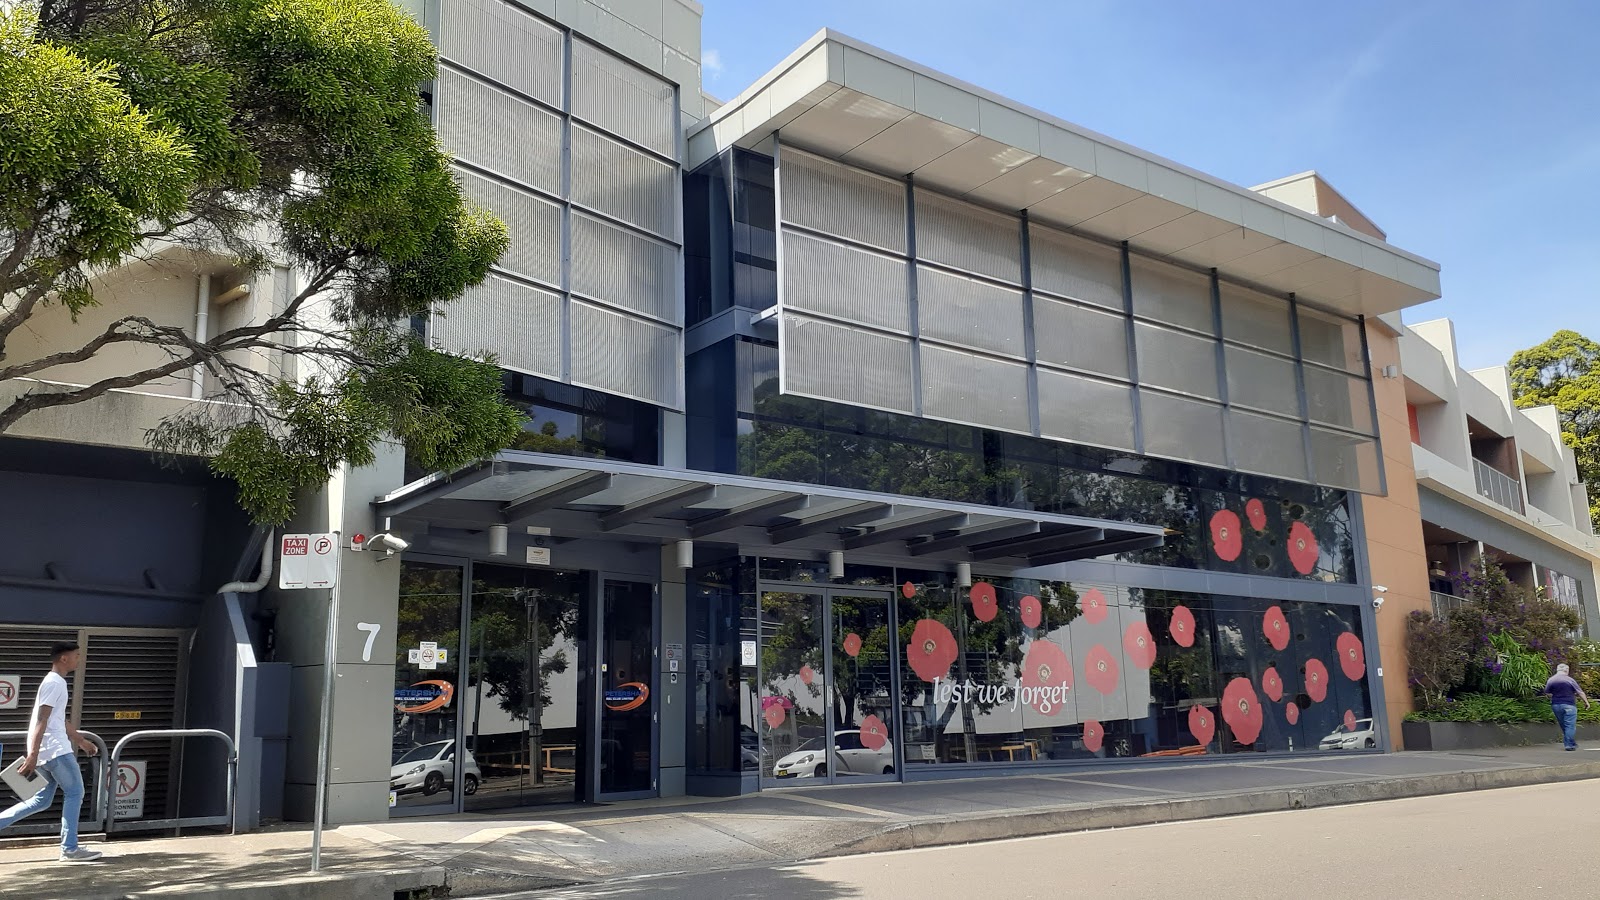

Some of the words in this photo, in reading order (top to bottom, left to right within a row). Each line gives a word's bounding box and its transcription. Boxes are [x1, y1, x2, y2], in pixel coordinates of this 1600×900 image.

[286, 539, 306, 547] TAXI
[285, 547, 306, 555] ZONE
[357, 622, 381, 662] 7
[394, 689, 449, 697] PETERSHAM
[932, 675, 972, 705] lest
[978, 683, 1007, 704] we
[1010, 676, 1070, 714] forget
